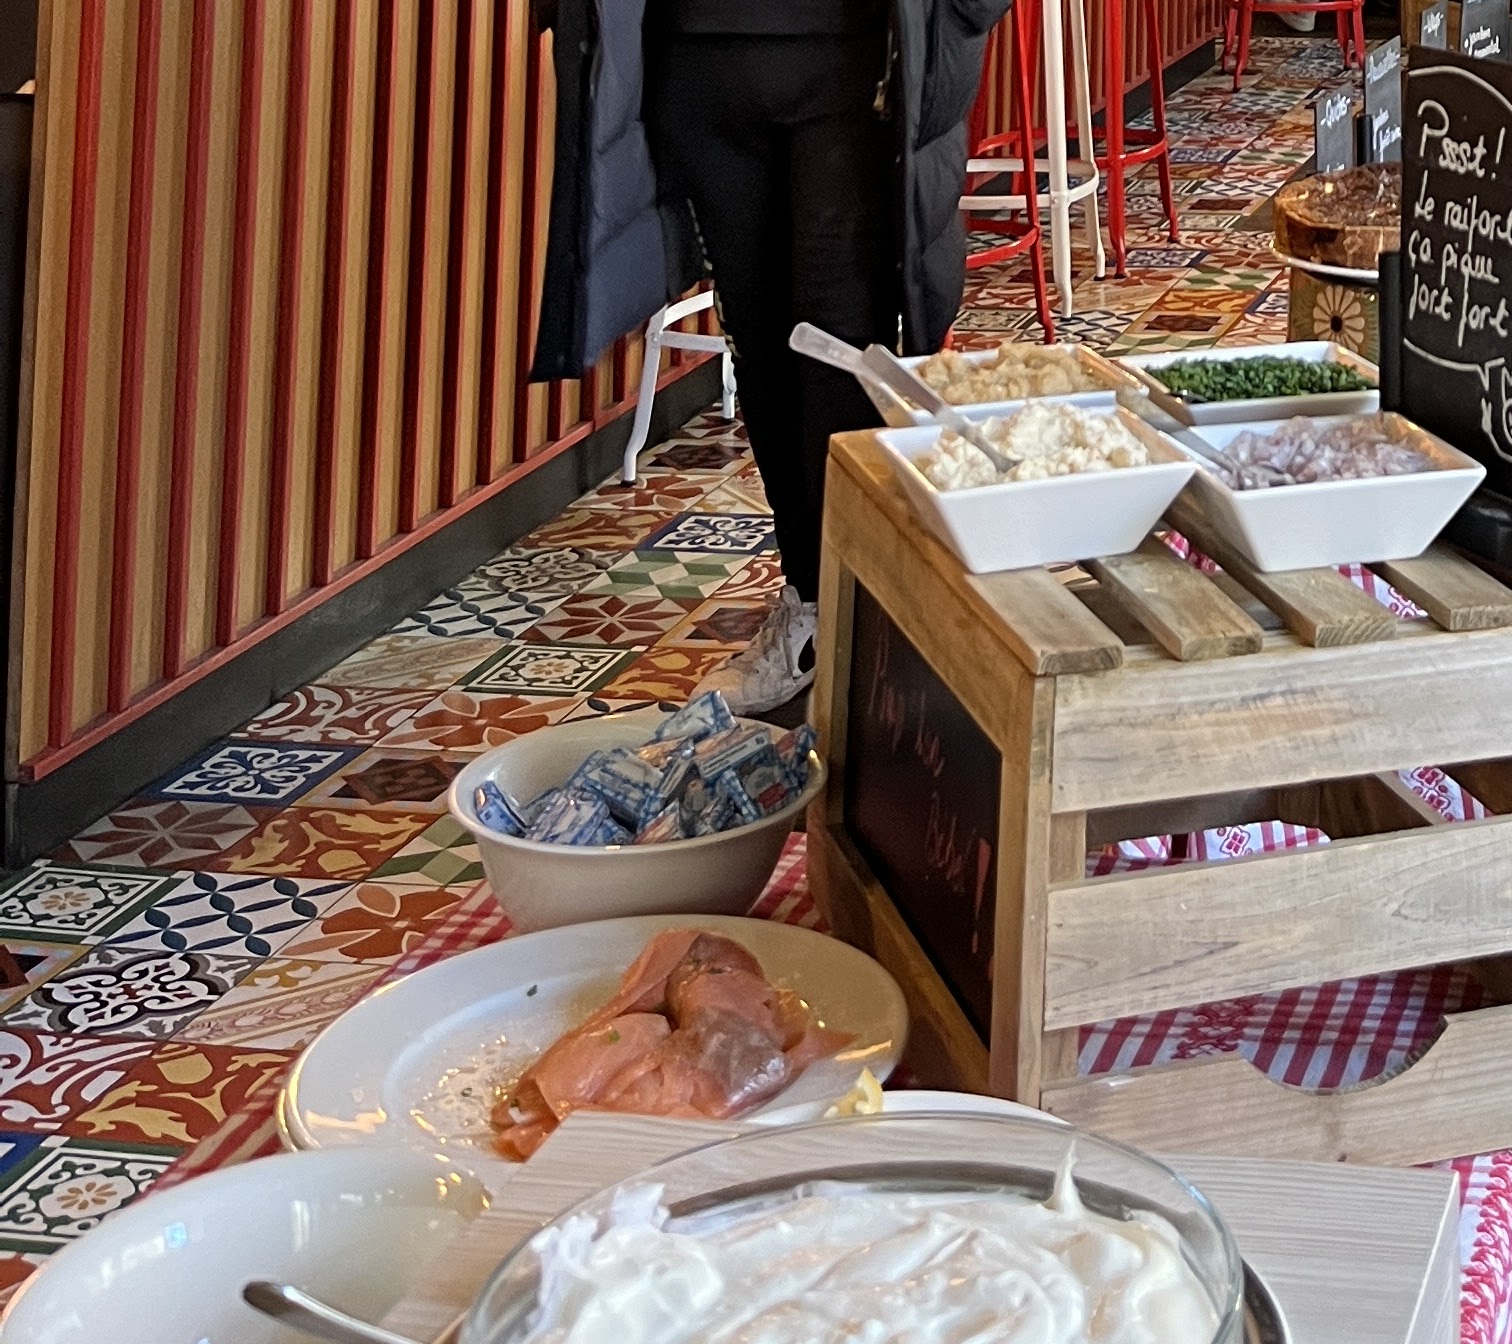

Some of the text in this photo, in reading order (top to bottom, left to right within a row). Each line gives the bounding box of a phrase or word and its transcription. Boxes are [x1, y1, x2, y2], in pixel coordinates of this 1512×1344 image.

[1408, 228, 1500, 287] ça pique
[1408, 272, 1454, 321] fort
